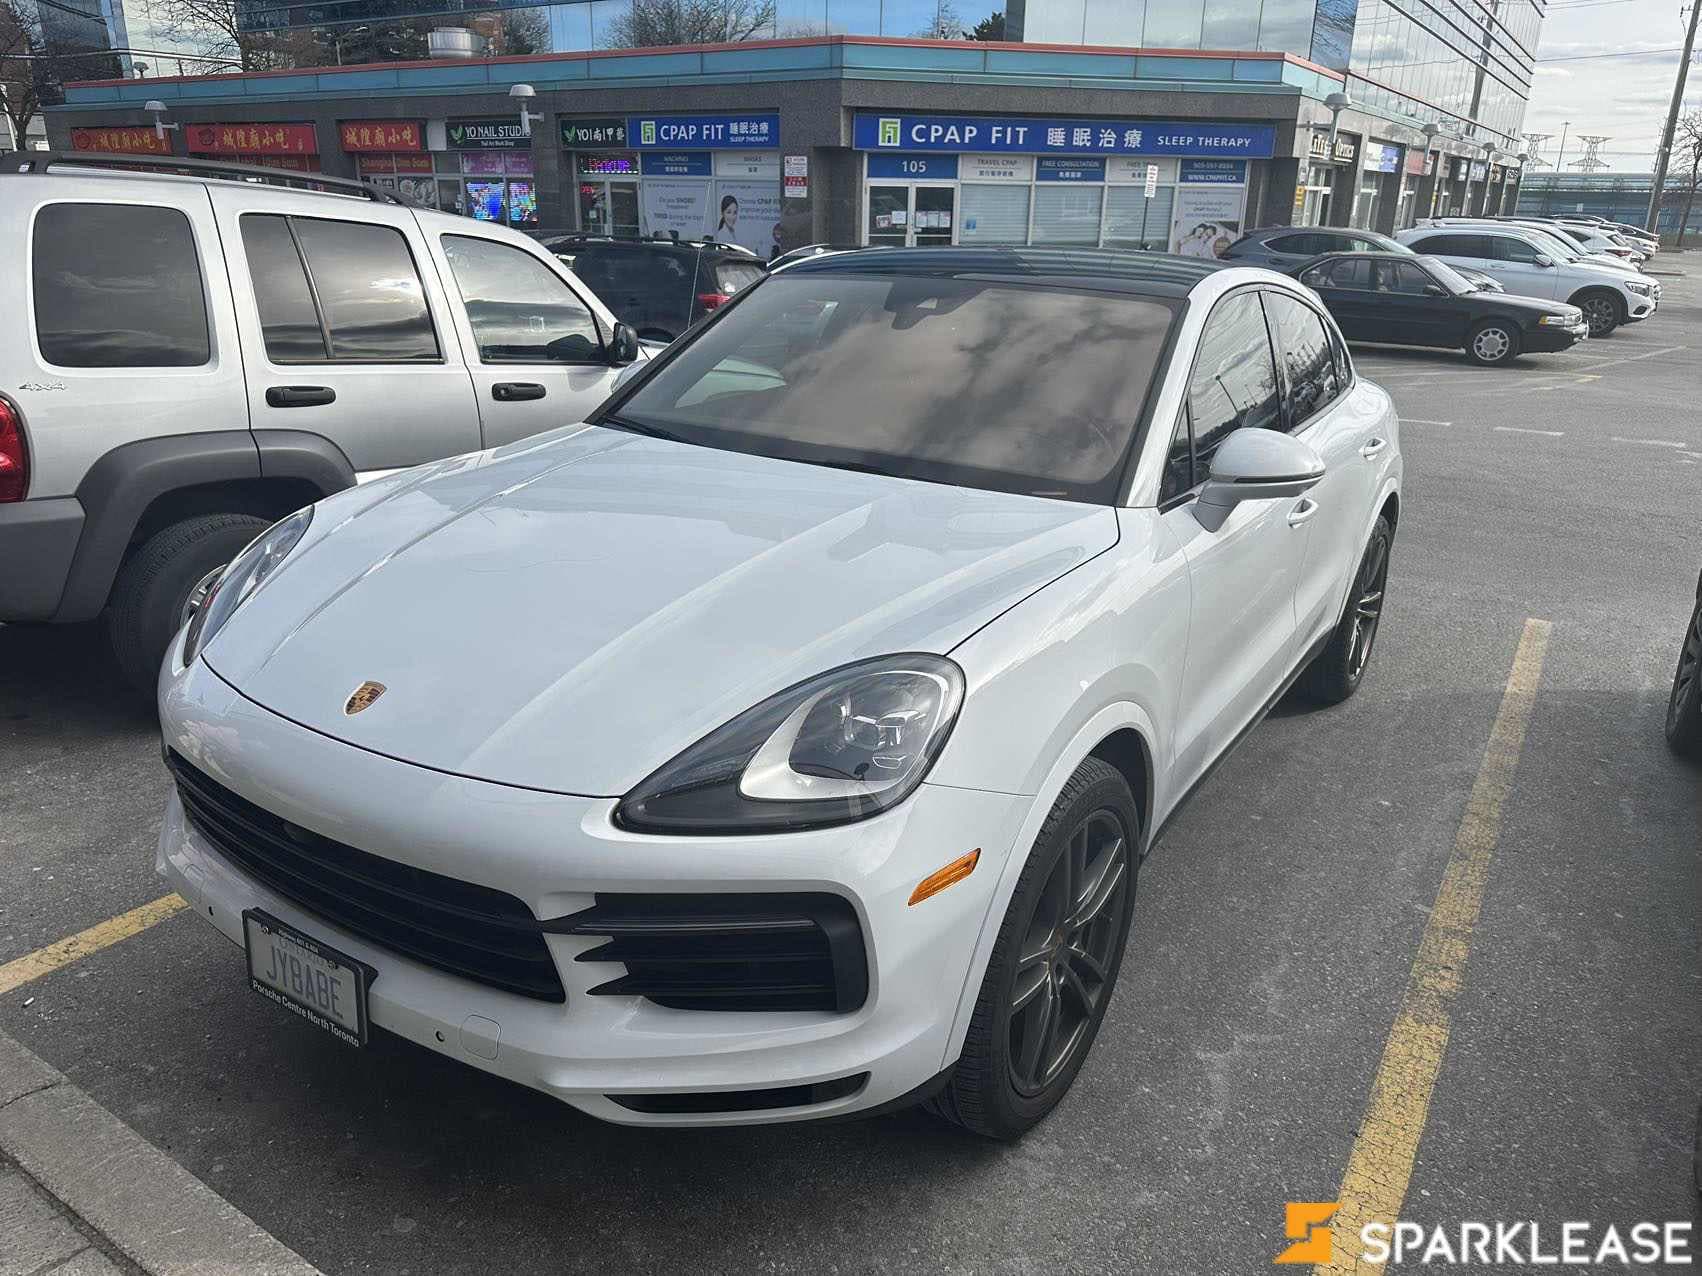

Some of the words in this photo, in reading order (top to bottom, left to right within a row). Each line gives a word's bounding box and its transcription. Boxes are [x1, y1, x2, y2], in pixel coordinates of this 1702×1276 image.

[465, 126, 477, 138] YO
[478, 126, 497, 137] NAIL
[660, 125, 697, 140] CPAP
[702, 125, 724, 140] FIT
[911, 124, 978, 144] CPAP
[991, 126, 1028, 145] FIT
[1047, 127, 1143, 148] 睡眠治療
[1157, 135, 1193, 146] SLEEP
[1198, 136, 1251, 147] THERAPY
[901, 160, 927, 173] 105
[266, 945, 344, 1020] JYBABE
[252, 979, 282, 1004] Porsche
[282, 995, 307, 1017] Centre
[307, 1009, 330, 1032] North
[329, 1022, 360, 1047] Toronto
